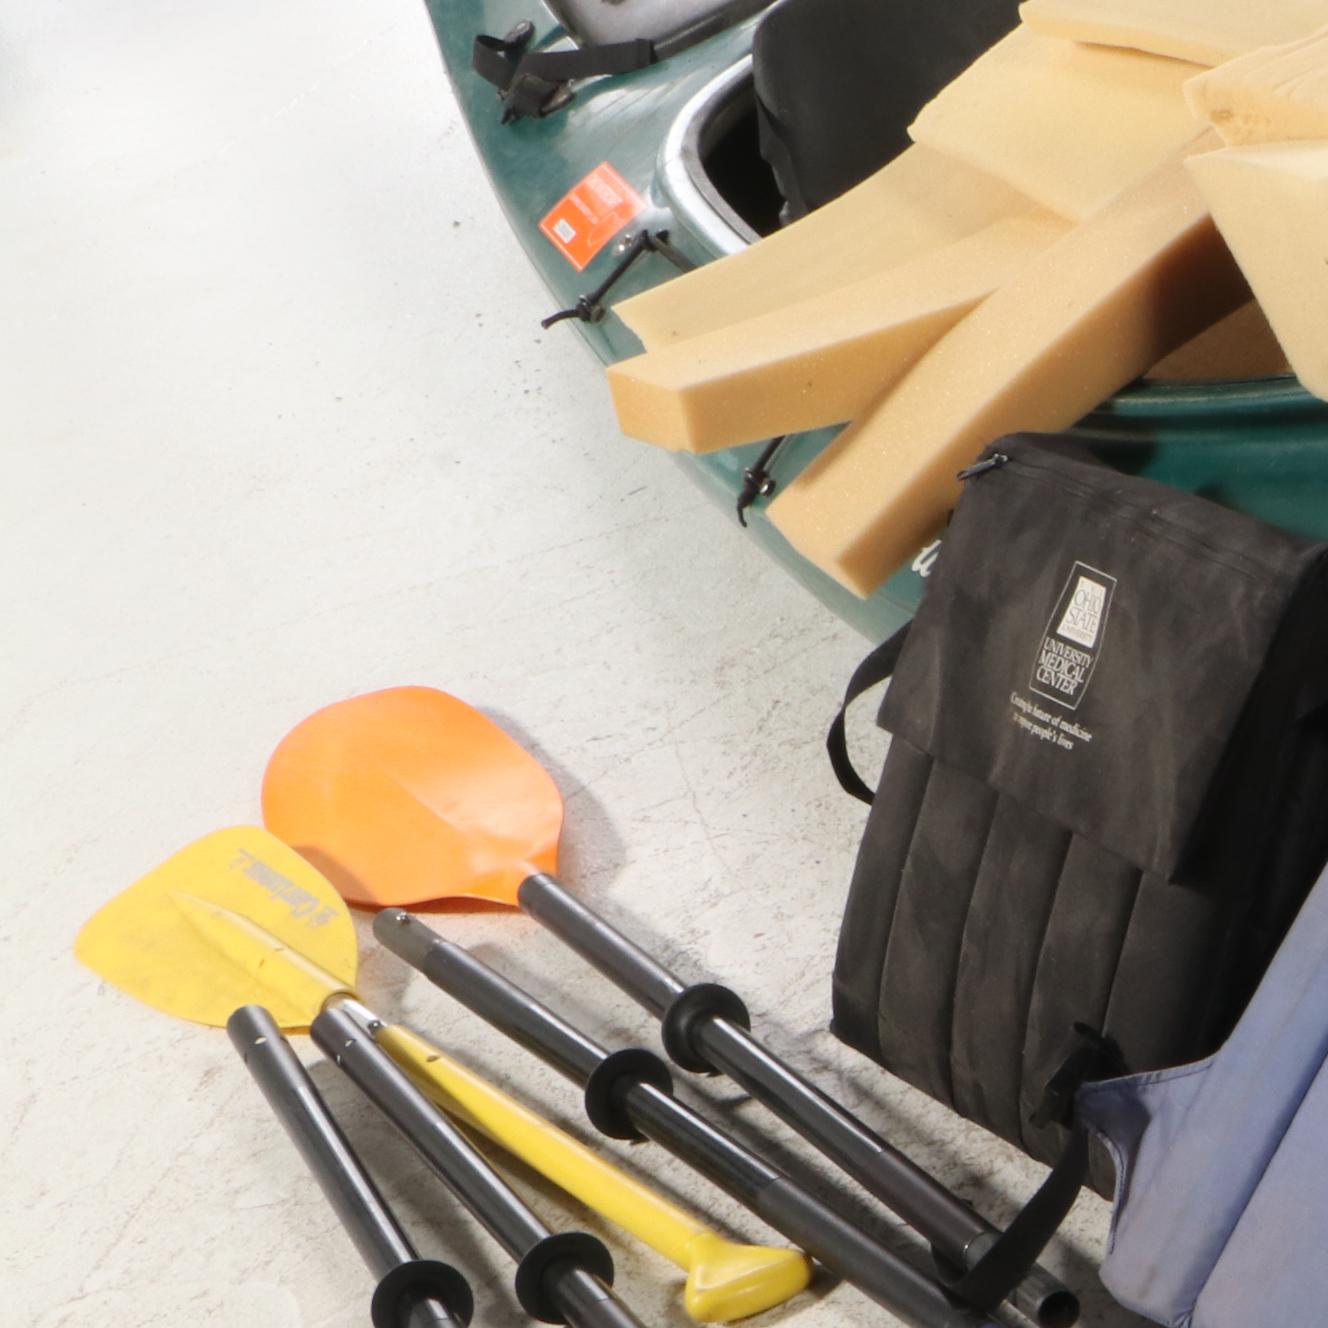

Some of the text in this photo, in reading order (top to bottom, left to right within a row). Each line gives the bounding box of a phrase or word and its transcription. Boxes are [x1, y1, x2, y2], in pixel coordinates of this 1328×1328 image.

[1075, 589, 1101, 614] OHIO
[1066, 607, 1097, 633] STATE
[1039, 650, 1085, 683] MEDICAL
[1044, 637, 1092, 668] UNIVERSITY
[1036, 665, 1078, 695] CENTER
